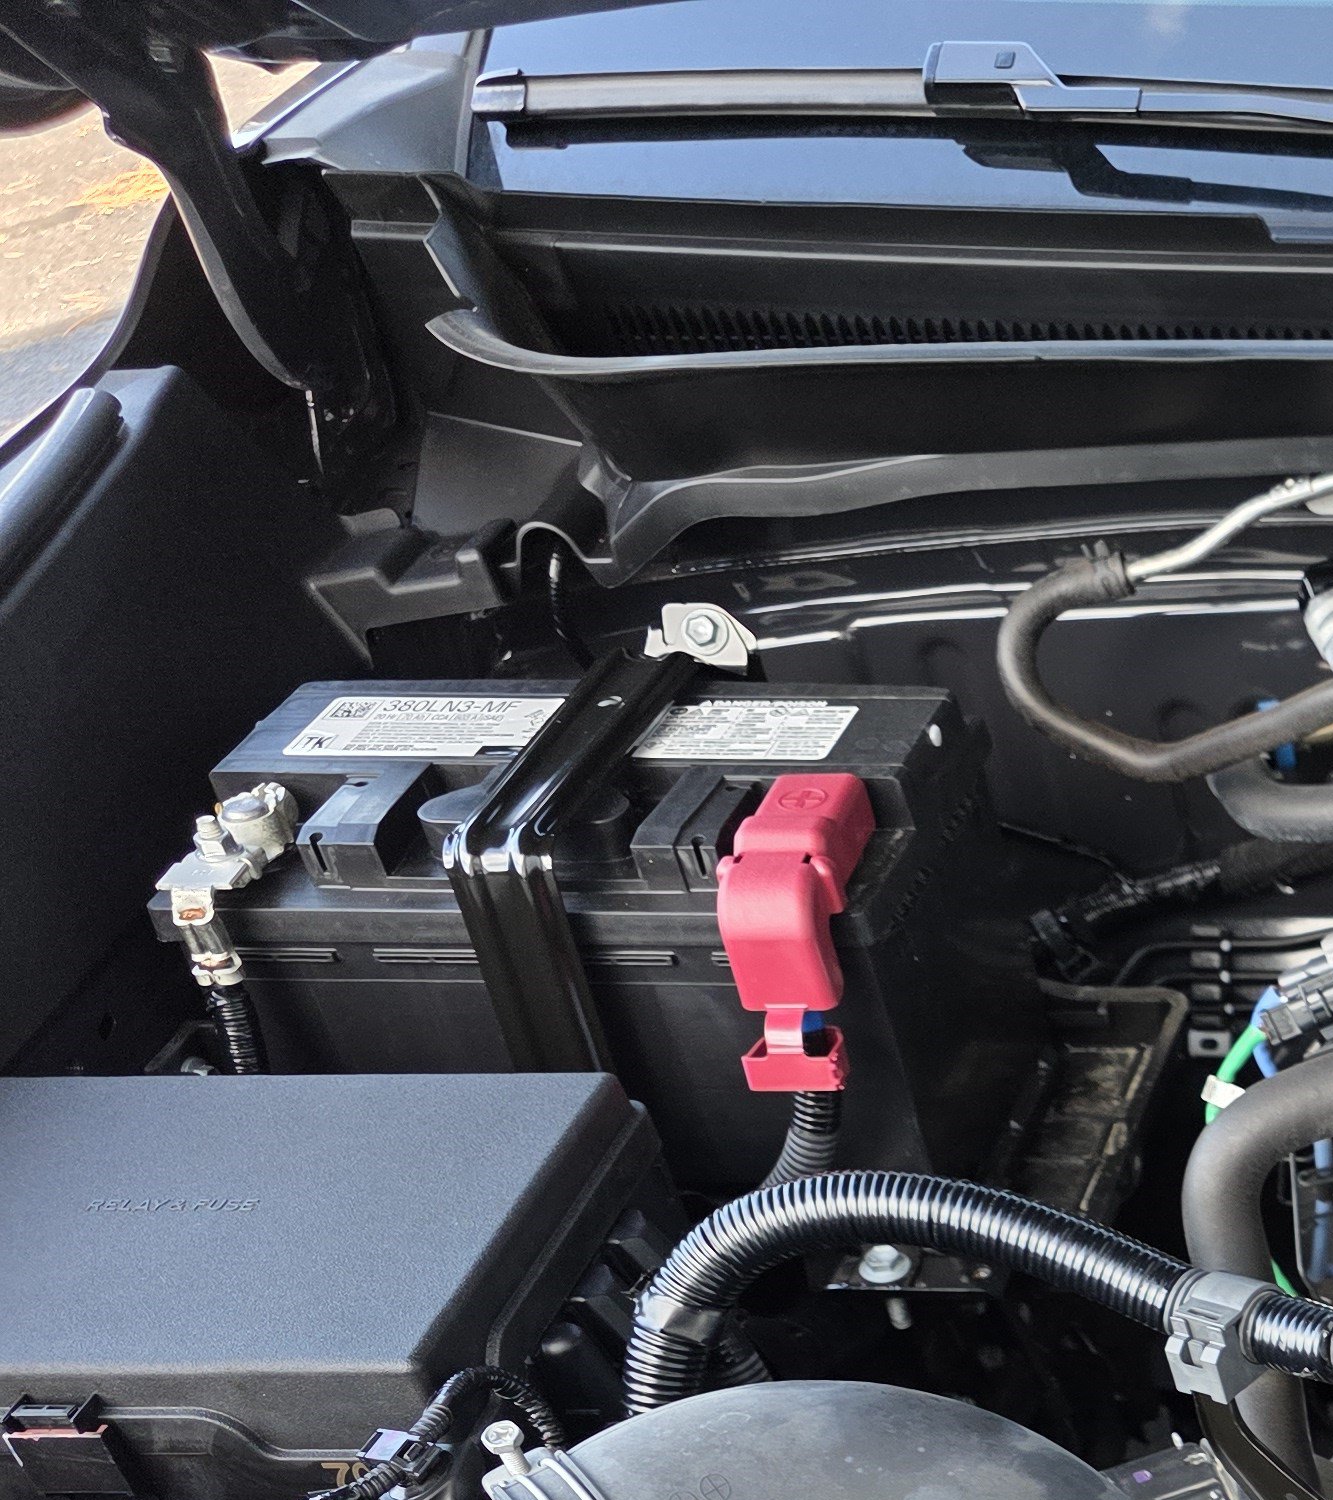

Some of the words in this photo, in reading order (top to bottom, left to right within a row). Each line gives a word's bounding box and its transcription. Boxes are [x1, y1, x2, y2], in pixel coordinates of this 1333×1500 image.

[382, 700, 521, 713] 380LN3-MF
[86, 1198, 170, 1212] RELAY
[193, 1198, 261, 1212] FUSE
